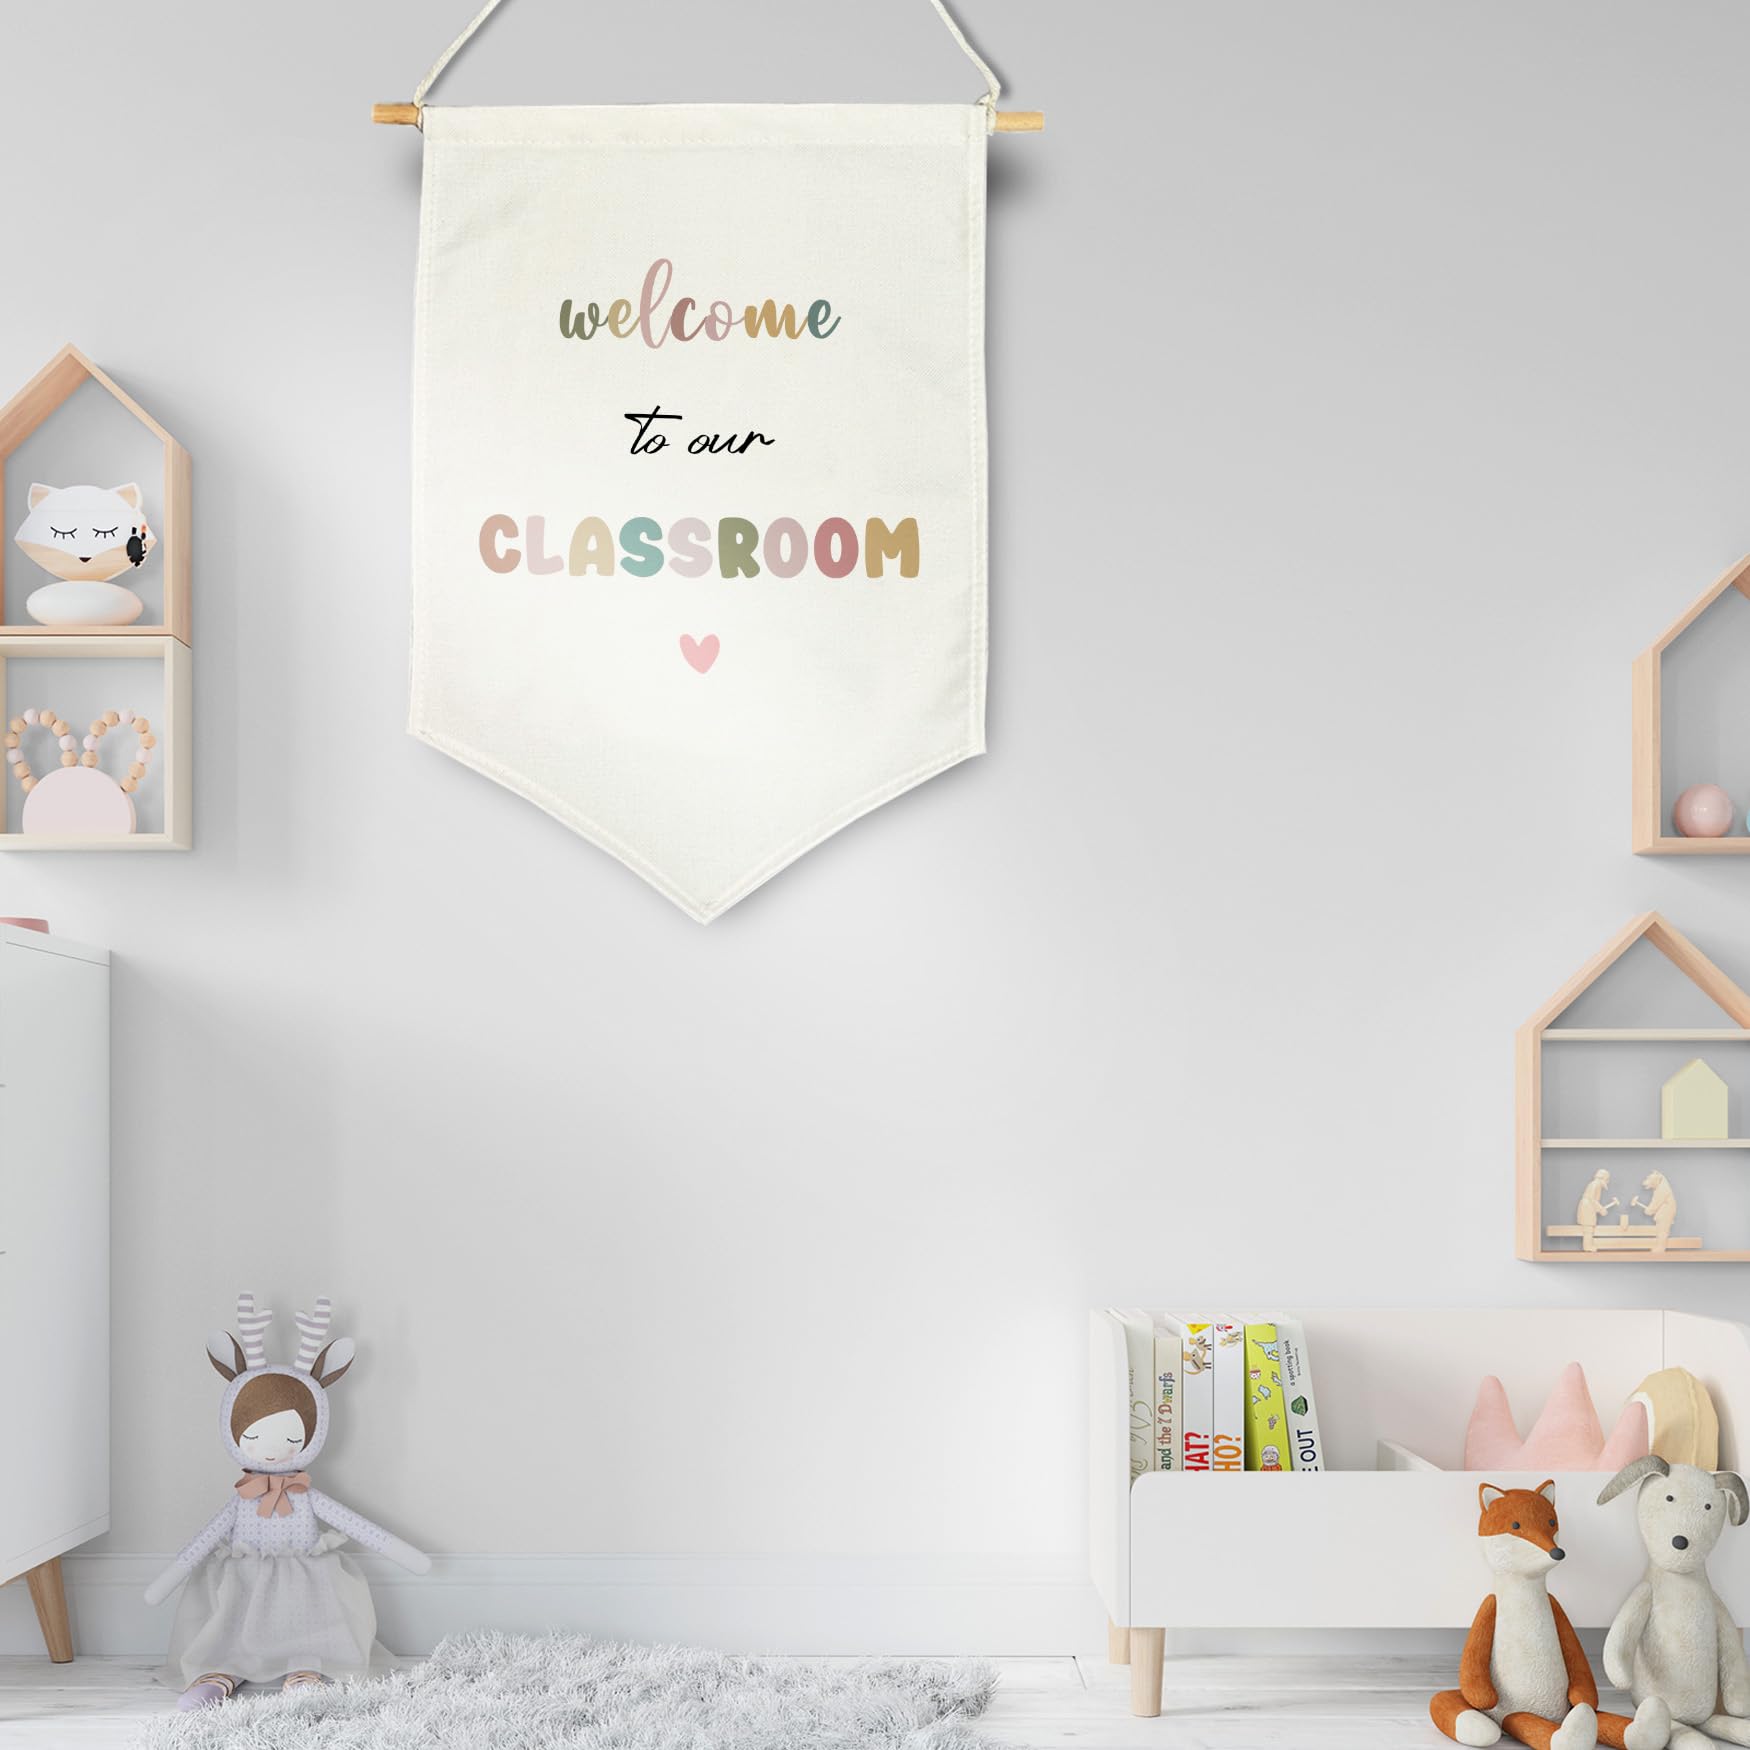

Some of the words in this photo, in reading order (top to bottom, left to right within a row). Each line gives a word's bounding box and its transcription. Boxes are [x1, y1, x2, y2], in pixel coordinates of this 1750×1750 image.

[559, 258, 842, 349] welcome
[624, 405, 683, 455] to
[687, 430, 775, 455] our
[478, 513, 920, 579] CLASSROOM
[1283, 1339, 1291, 1355] book
[1286, 1354, 1296, 1381] spotting
[1158, 1371, 1175, 1415] Dwarfs
[1157, 1426, 1172, 1446] the
[1296, 1429, 1317, 1462] OUT
[1157, 1448, 1174, 1471] and
